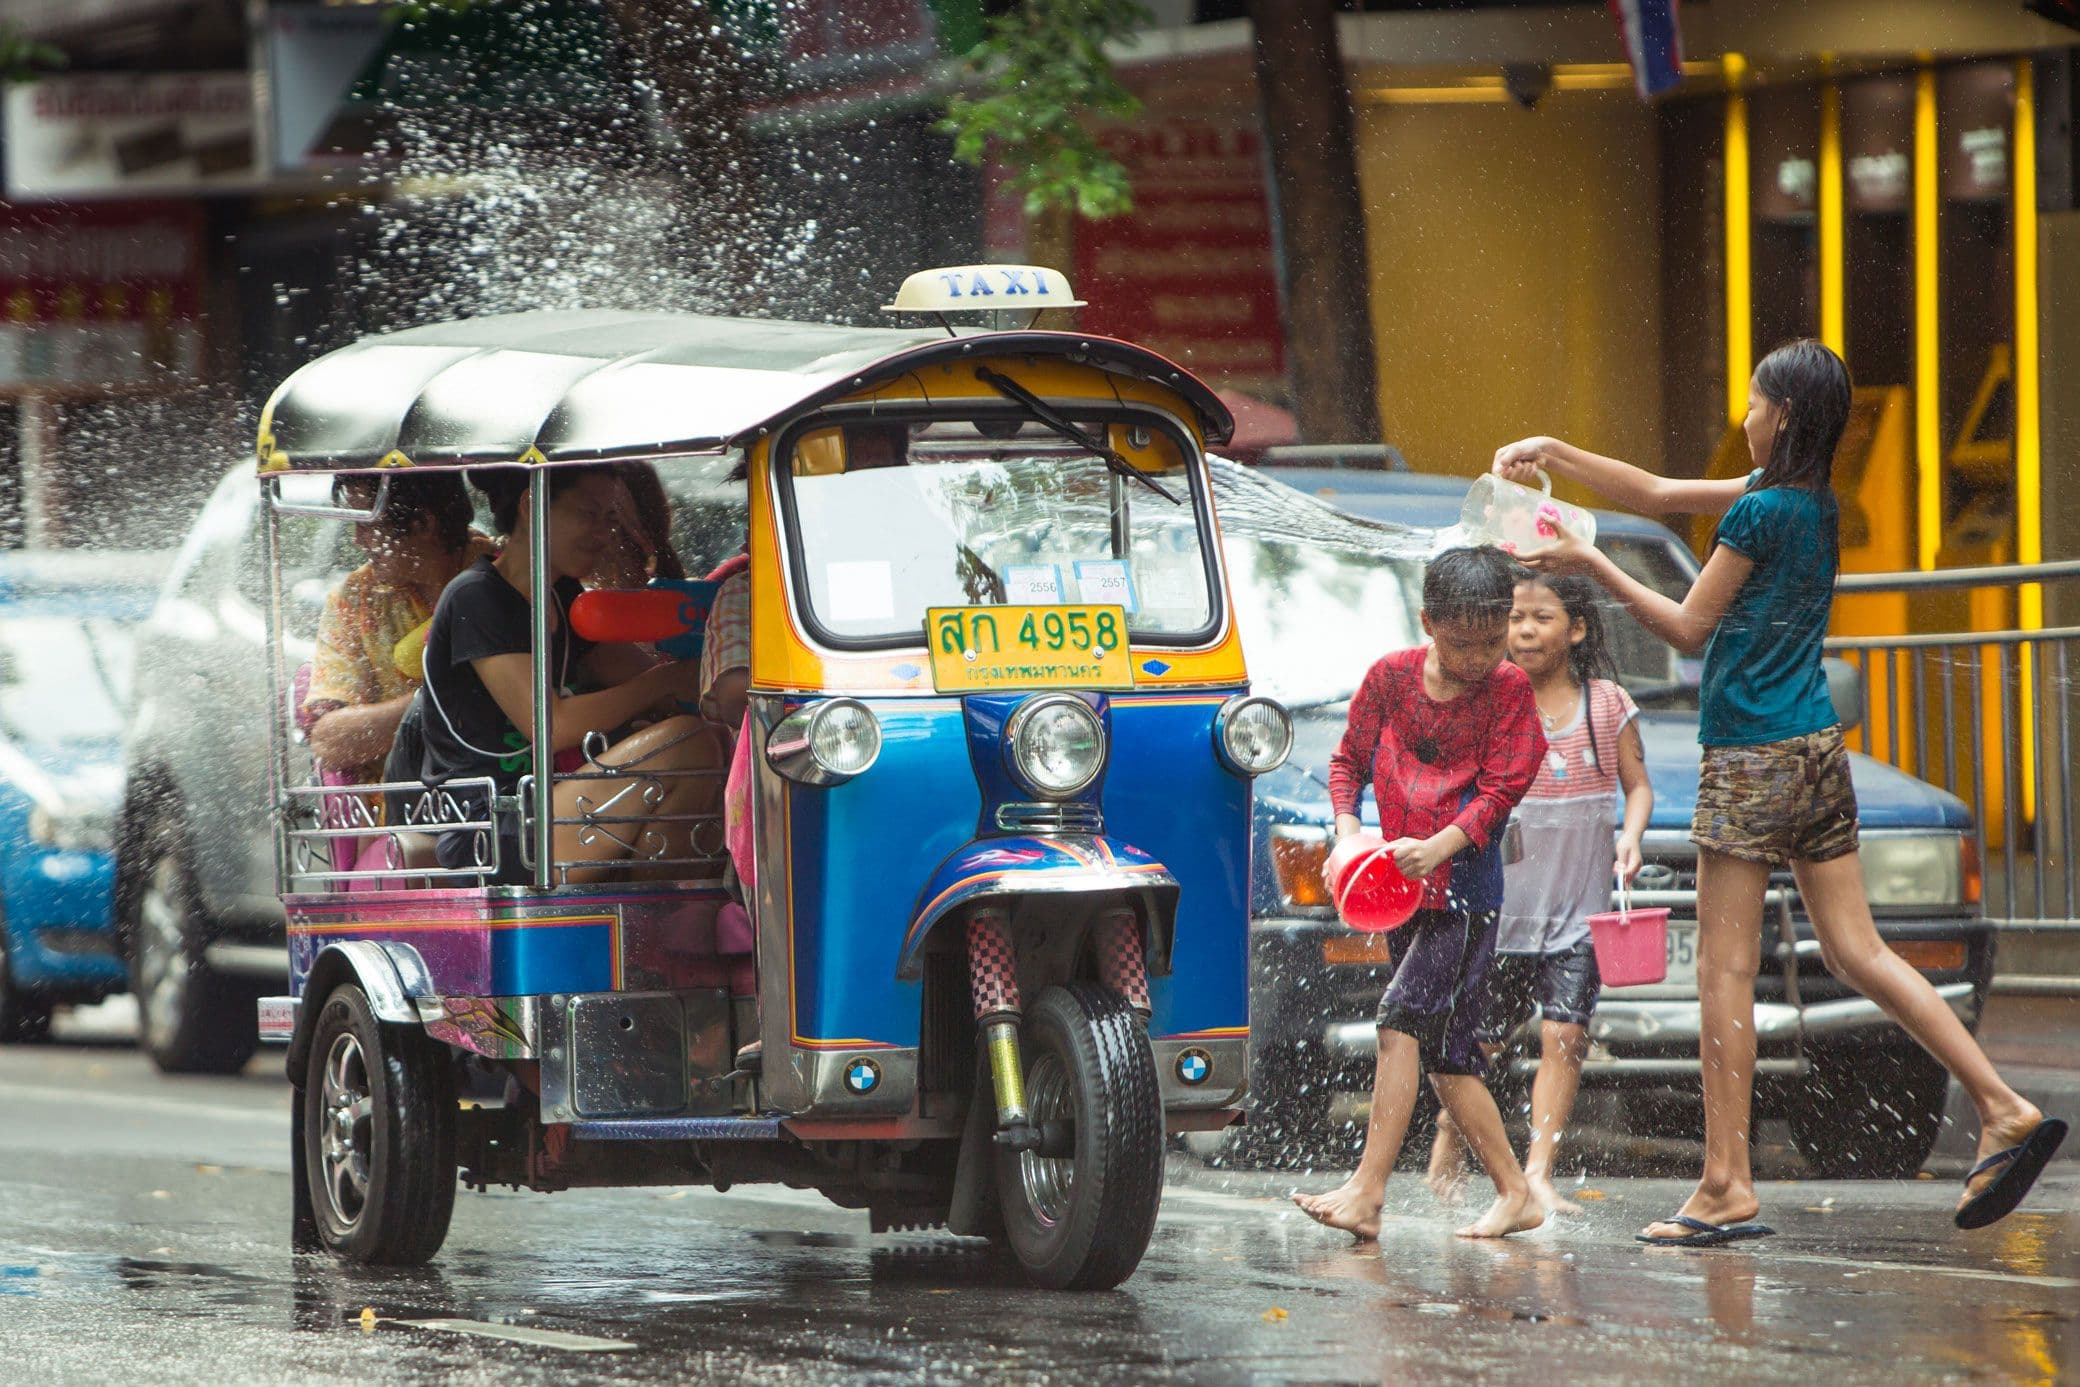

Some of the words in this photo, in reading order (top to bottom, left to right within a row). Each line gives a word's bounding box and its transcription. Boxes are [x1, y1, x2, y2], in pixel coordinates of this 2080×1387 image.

[940, 270, 1049, 296] TAXI
[1029, 582, 1057, 593] 2556
[1101, 577, 1125, 588] 2557
[939, 612, 999, 655] สก
[1018, 611, 1118, 651] 4958
[966, 664, 1102, 686] กรุงเทพมหานคร
